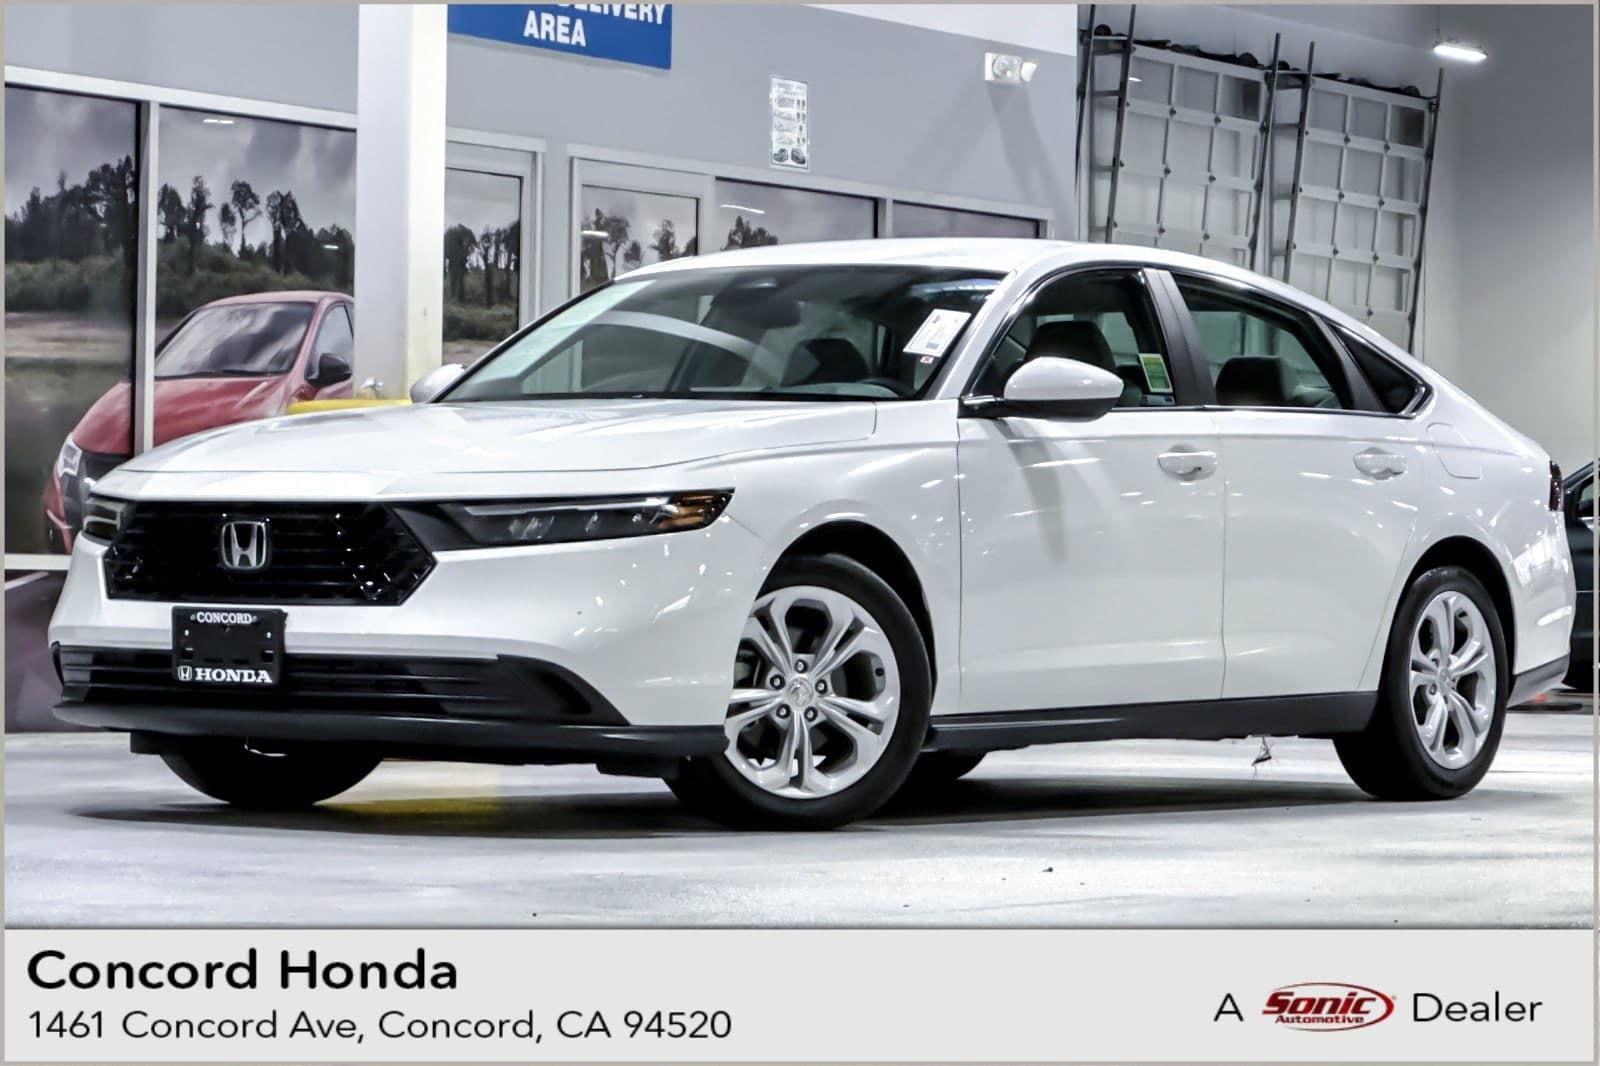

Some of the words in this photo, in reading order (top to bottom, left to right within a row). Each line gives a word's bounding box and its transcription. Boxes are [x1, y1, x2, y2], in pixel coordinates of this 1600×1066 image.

[557, 4, 666, 24] VERY
[523, 10, 587, 47] AREA
[195, 611, 253, 625] CONCORD
[194, 667, 273, 684] HONDA
